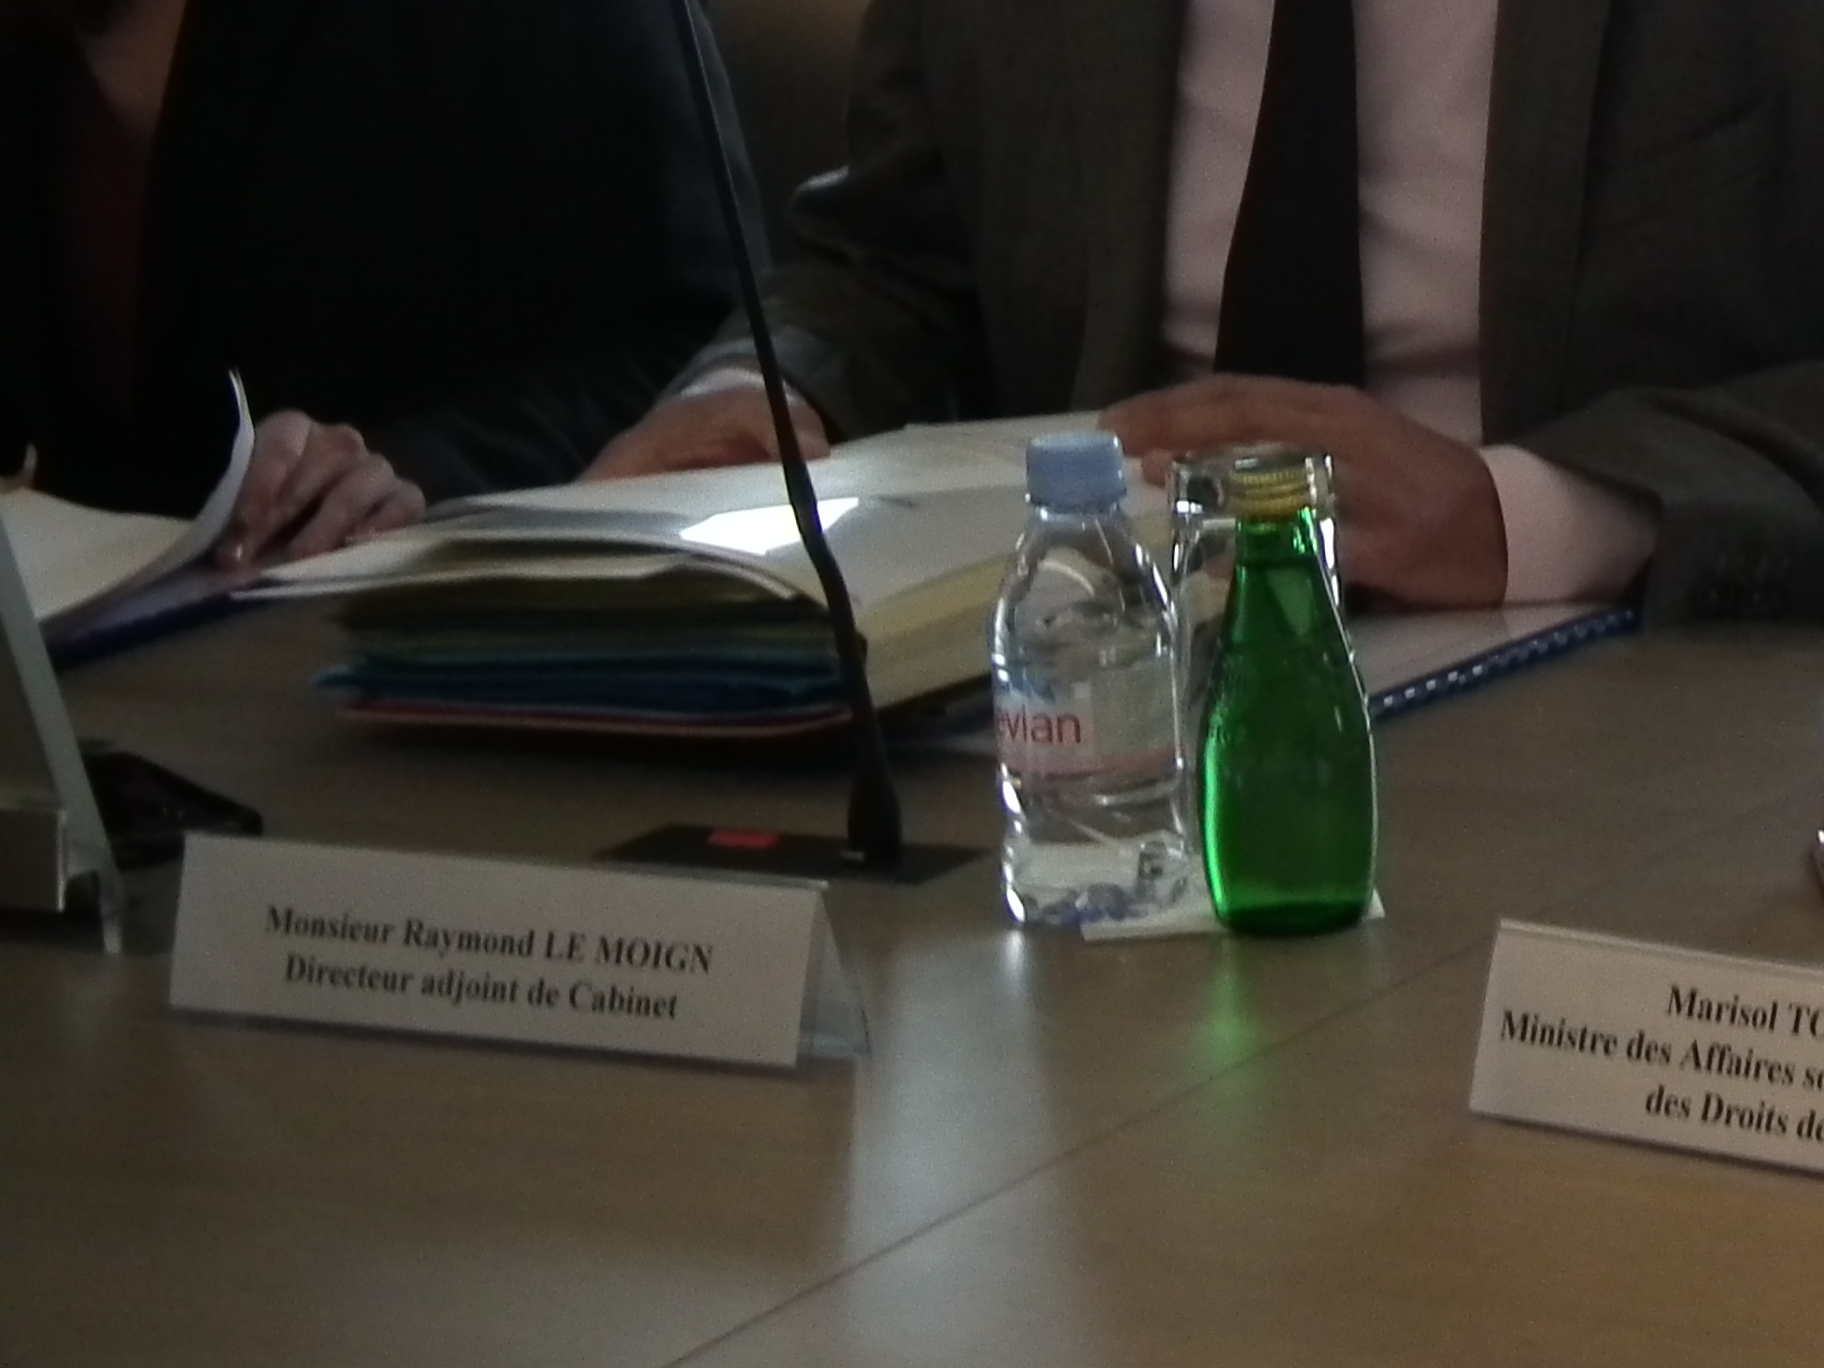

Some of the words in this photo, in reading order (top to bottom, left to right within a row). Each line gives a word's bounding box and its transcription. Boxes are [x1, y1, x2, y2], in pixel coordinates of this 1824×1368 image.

[267, 905, 394, 944] Monsieur
[403, 916, 535, 958] Raymond
[545, 931, 588, 961] LE
[596, 934, 713, 974] MOIGN
[286, 952, 414, 992] Directeur
[420, 969, 519, 1005] adjoint
[527, 978, 560, 1007] de
[568, 980, 678, 1020] Cabinet
[1667, 983, 1779, 1033] Marisol
[1501, 1009, 1618, 1057] Ministre
[1626, 1028, 1673, 1065] des
[1680, 1038, 1795, 1087] Affaires
[1645, 1083, 1692, 1120] des
[1700, 1091, 1789, 1135] Droits
